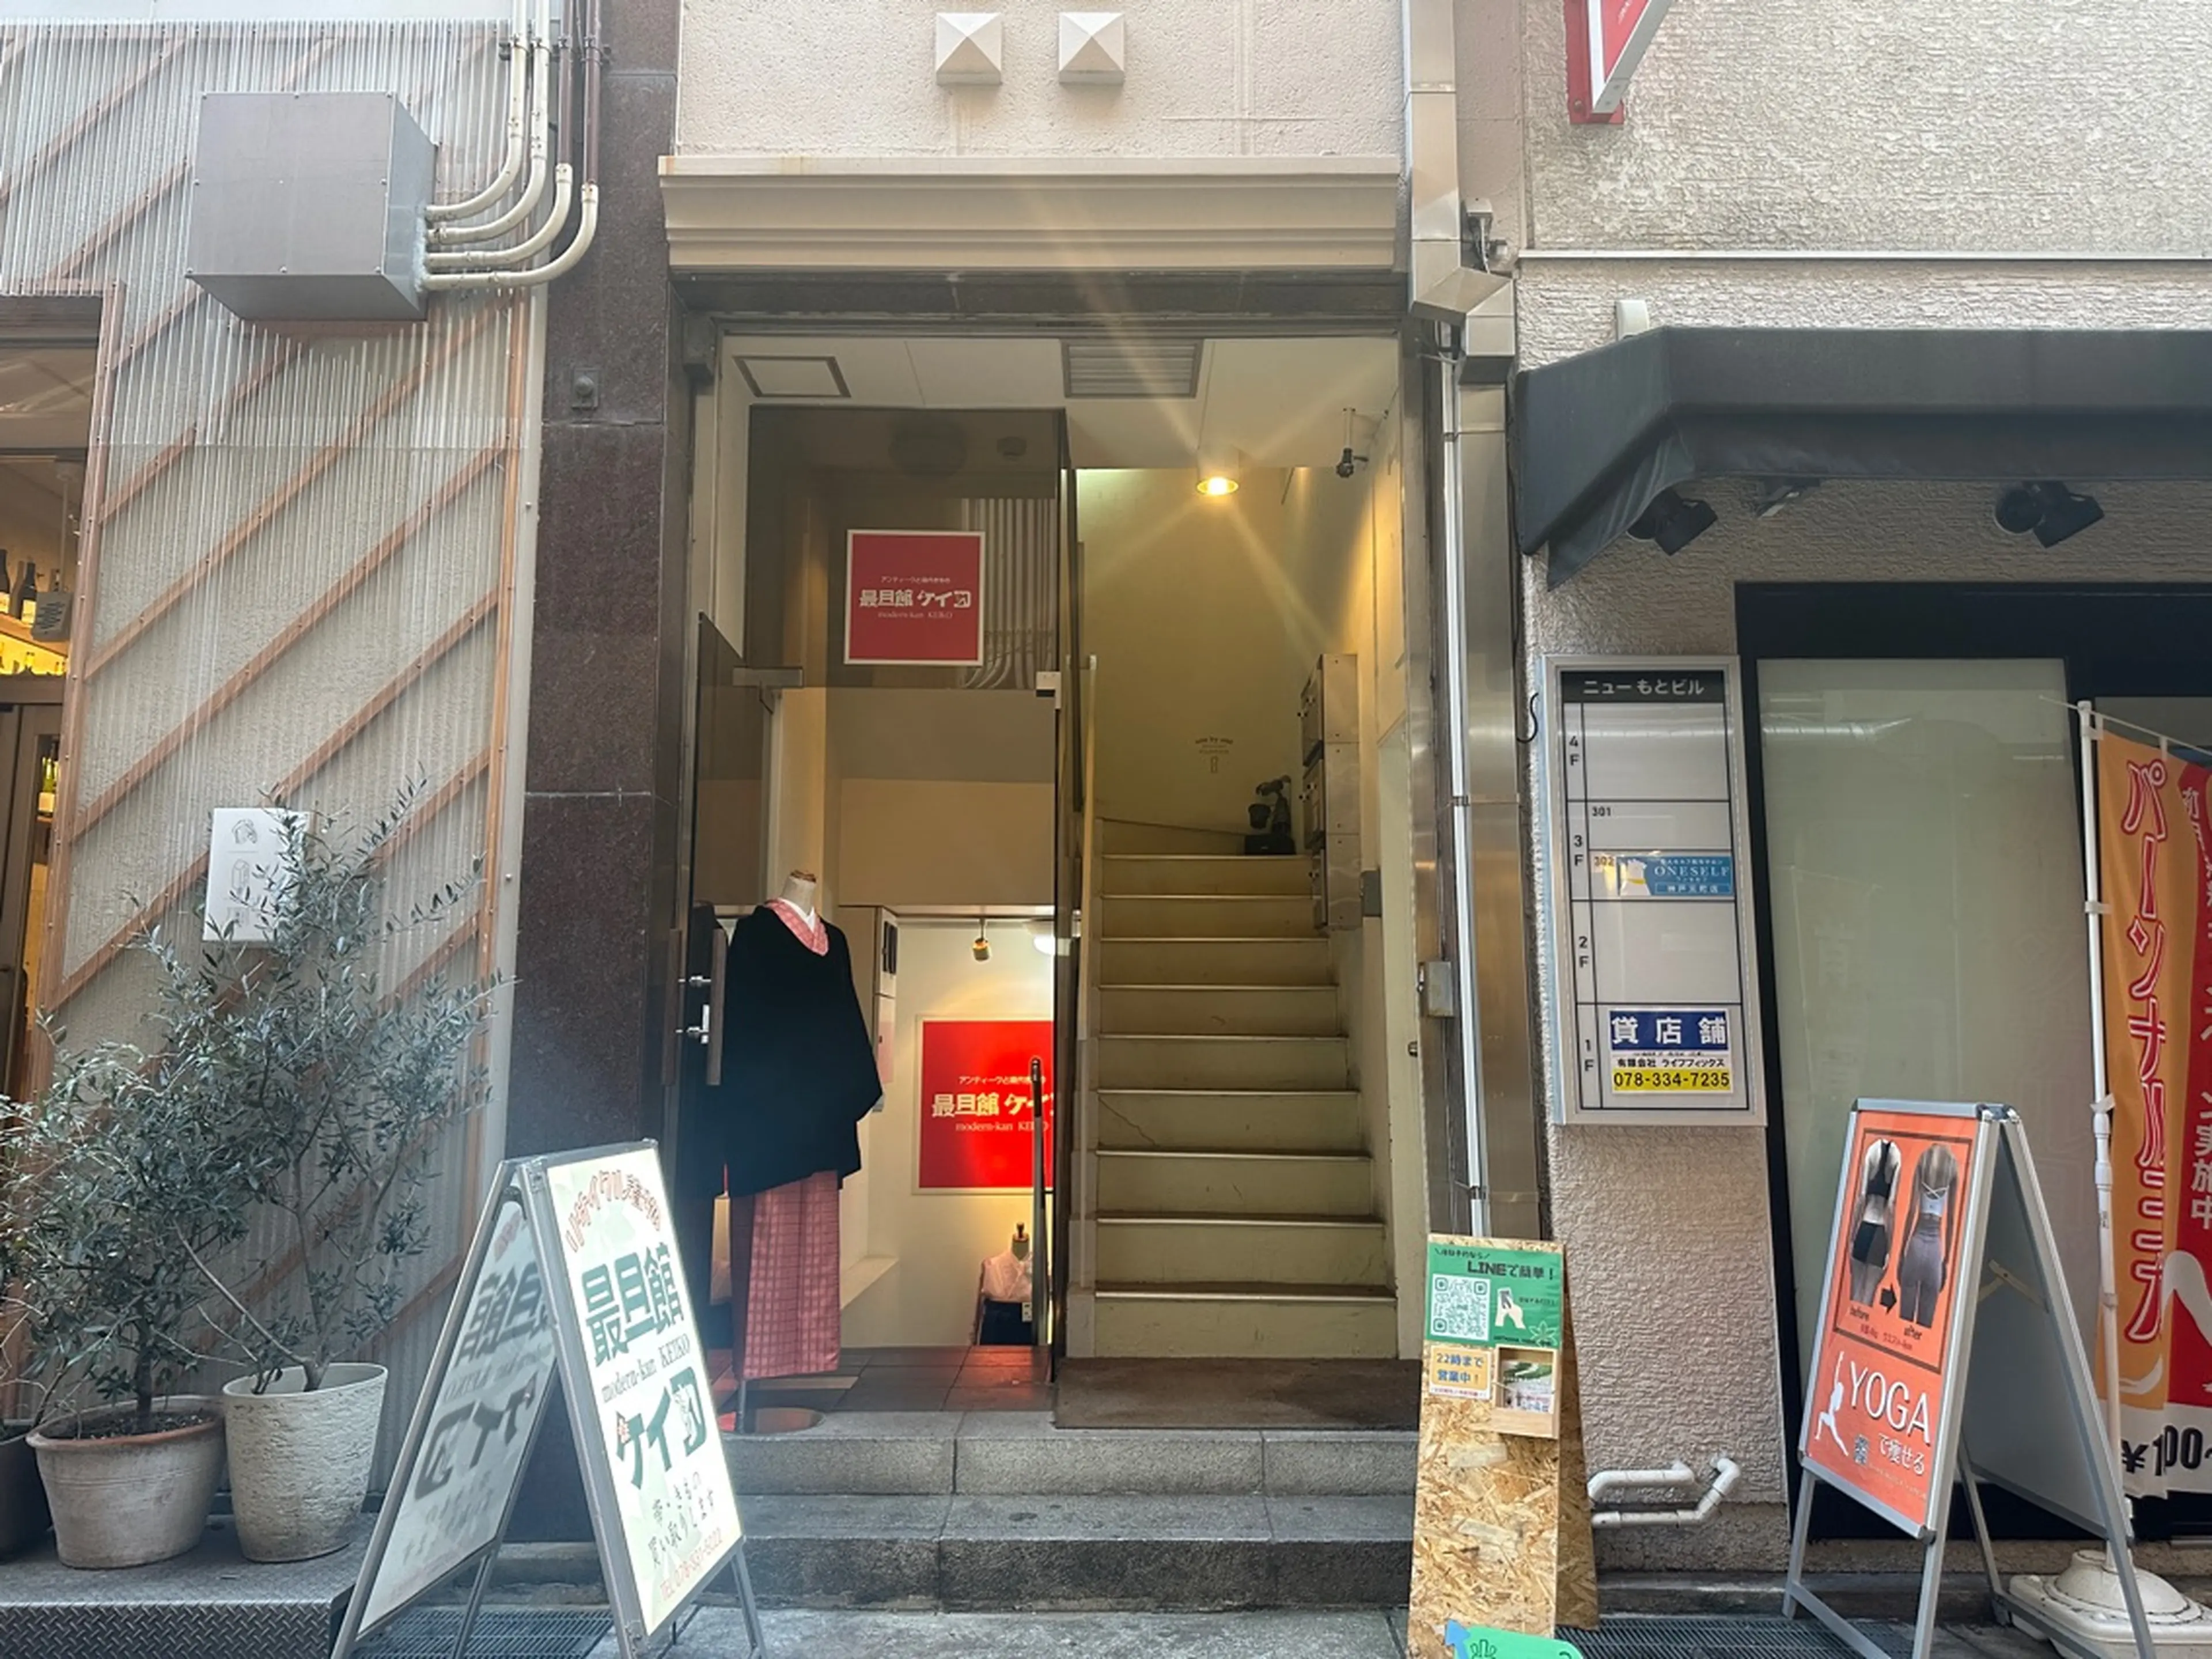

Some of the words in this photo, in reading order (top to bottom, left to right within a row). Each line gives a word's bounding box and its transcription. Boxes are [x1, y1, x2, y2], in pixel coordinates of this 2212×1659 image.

[1583, 679, 1705, 695] ニューもとビル
[1592, 807, 1611, 817] 301
[1594, 856, 1613, 866] 302
[1654, 866, 1730, 876] ONESELF
[1613, 1072, 1730, 1087] 078-334-7235
[1850, 1360, 1931, 1448] YOGA
